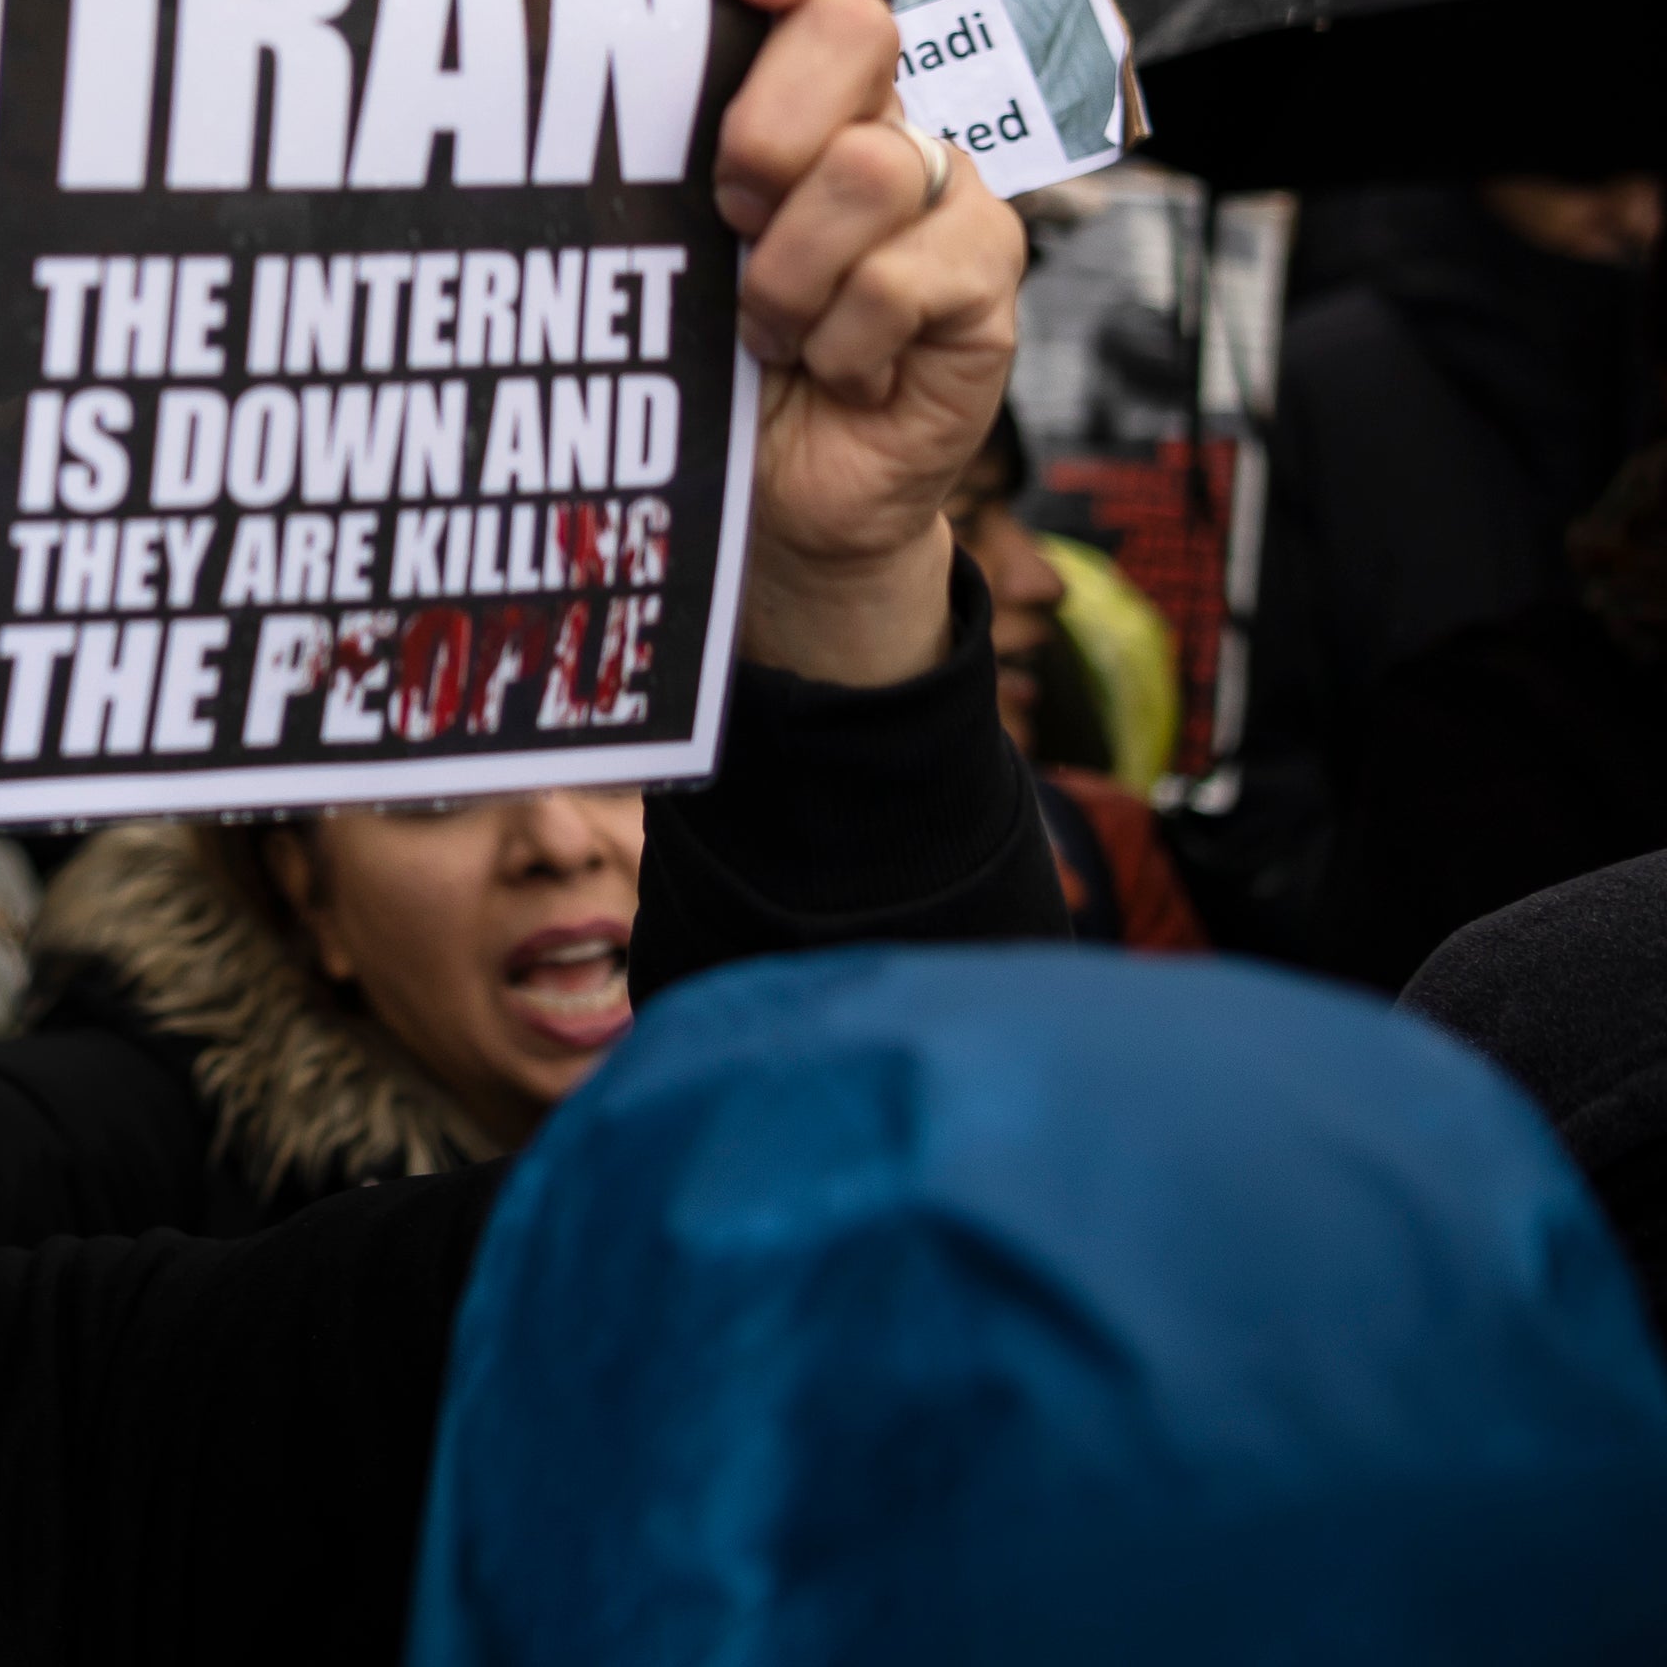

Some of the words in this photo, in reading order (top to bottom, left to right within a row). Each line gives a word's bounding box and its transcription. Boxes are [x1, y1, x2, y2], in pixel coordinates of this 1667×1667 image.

[33, 254, 231, 379] THE
[245, 246, 687, 376] INTERNET
[18, 385, 133, 514] IS
[149, 379, 467, 510] DOWN
[479, 373, 681, 498] AND
[10, 516, 217, 616] THEY
[220, 510, 379, 606] ARE
[389, 496, 670, 598] KILLING
[241, 595, 662, 747] PEOPLE
